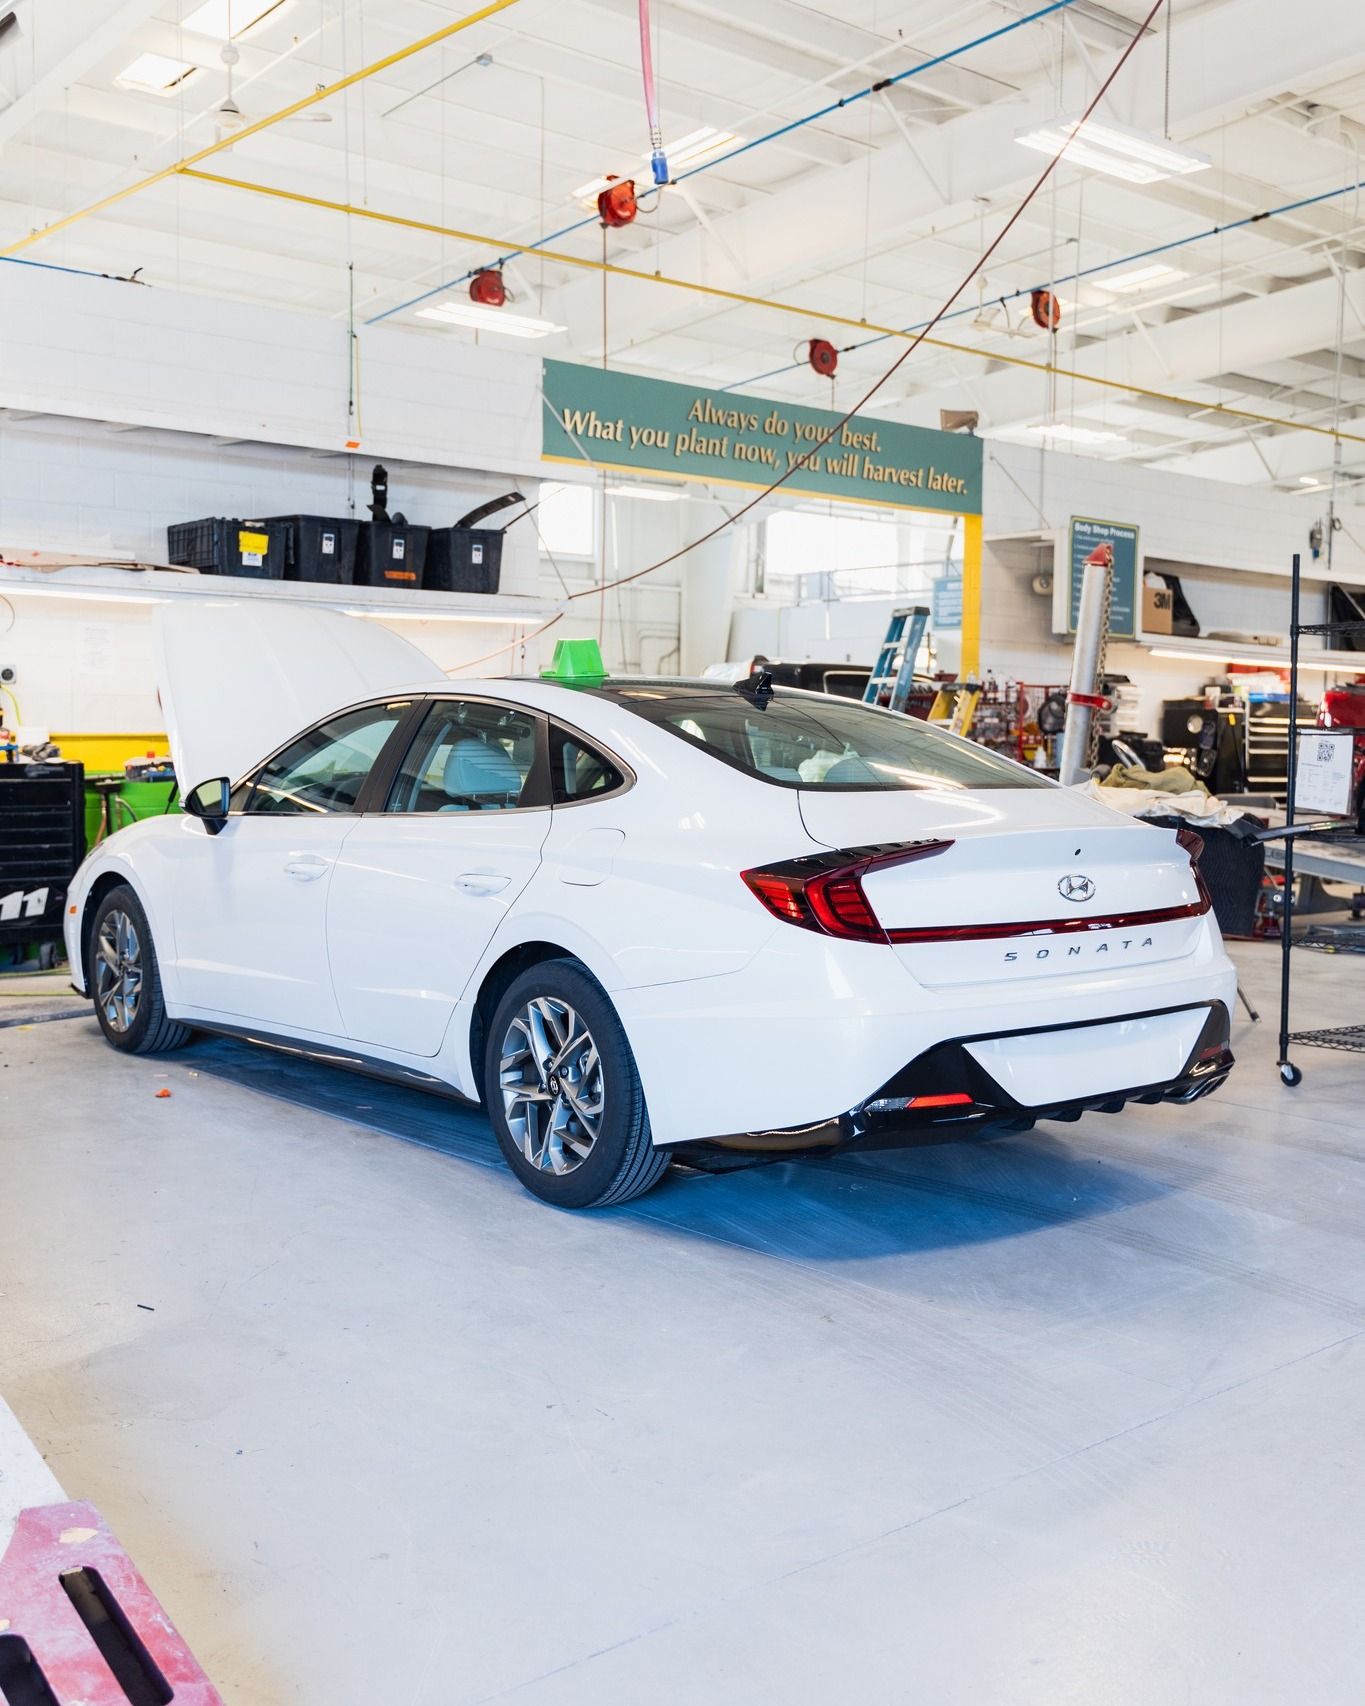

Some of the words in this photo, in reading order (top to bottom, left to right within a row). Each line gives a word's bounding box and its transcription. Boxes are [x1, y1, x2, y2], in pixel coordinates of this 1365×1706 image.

[688, 398, 759, 435] Always
[764, 410, 788, 436] do
[793, 421, 834, 445] your
[840, 423, 882, 453] best.
[563, 408, 625, 442] What
[629, 425, 670, 450] you
[674, 427, 728, 458] plant
[733, 441, 781, 470] now,
[785, 450, 821, 474] you
[825, 452, 860, 478] will
[862, 456, 923, 488] harvest
[926, 467, 968, 496] later.
[1075, 522, 1091, 535] Body
[1093, 525, 1109, 537] Shop
[1110, 527, 1135, 539] Process
[1153, 592, 1171, 610] 3M
[1004, 937, 1153, 962] SONATA
